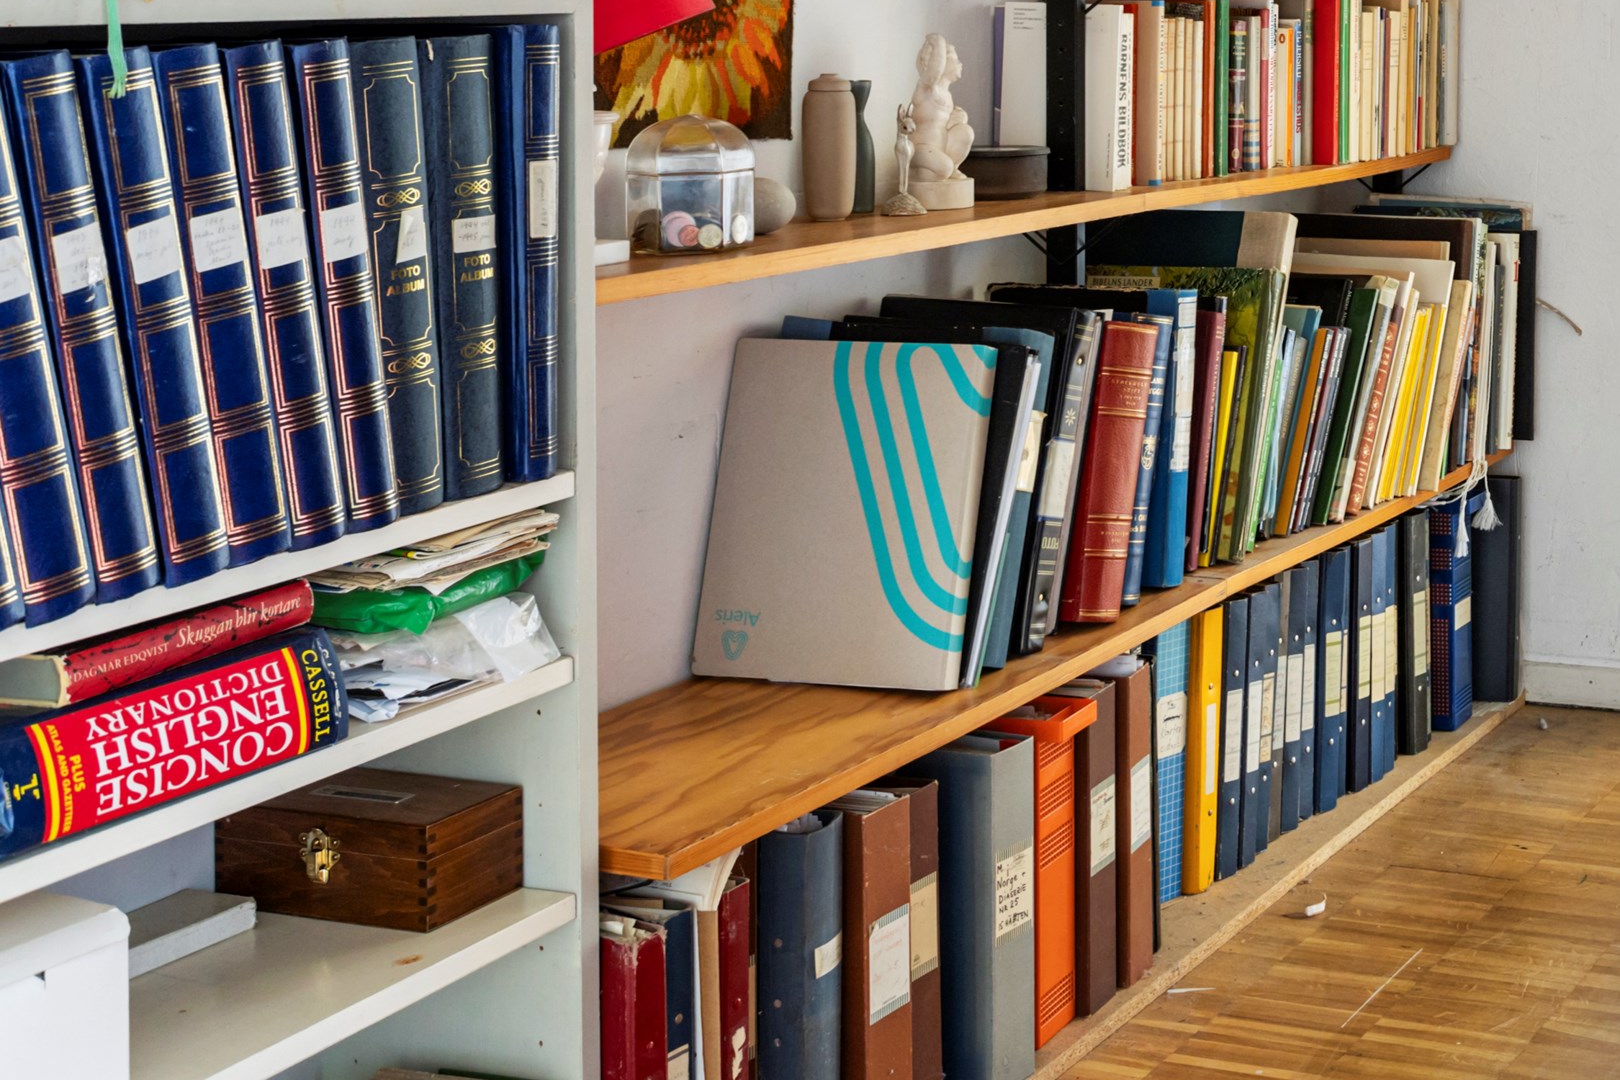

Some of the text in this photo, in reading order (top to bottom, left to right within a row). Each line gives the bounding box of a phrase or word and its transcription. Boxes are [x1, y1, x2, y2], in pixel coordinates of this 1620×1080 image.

[1117, 34, 1129, 169] BARNENS BILDBOK
[391, 265, 421, 280] FOTO
[461, 269, 494, 282] ALBUM
[464, 254, 491, 267] FOTO
[386, 279, 425, 296] ALBUM
[176, 595, 302, 648] Skuggan blir kortare
[715, 608, 761, 626] Aleris
[72, 643, 169, 683] DAGMAR EDQVIST
[85, 660, 284, 741] DICTIONARY
[301, 649, 331, 742] CASSELL
[91, 684, 290, 777] ENGLISH
[46, 724, 75, 834] ATLAS AND GAZETTEER
[69, 754, 86, 793] PLUS
[97, 721, 294, 816] CONCISE
[996, 874, 1018, 891] Norge
[1010, 896, 1019, 909] 25
